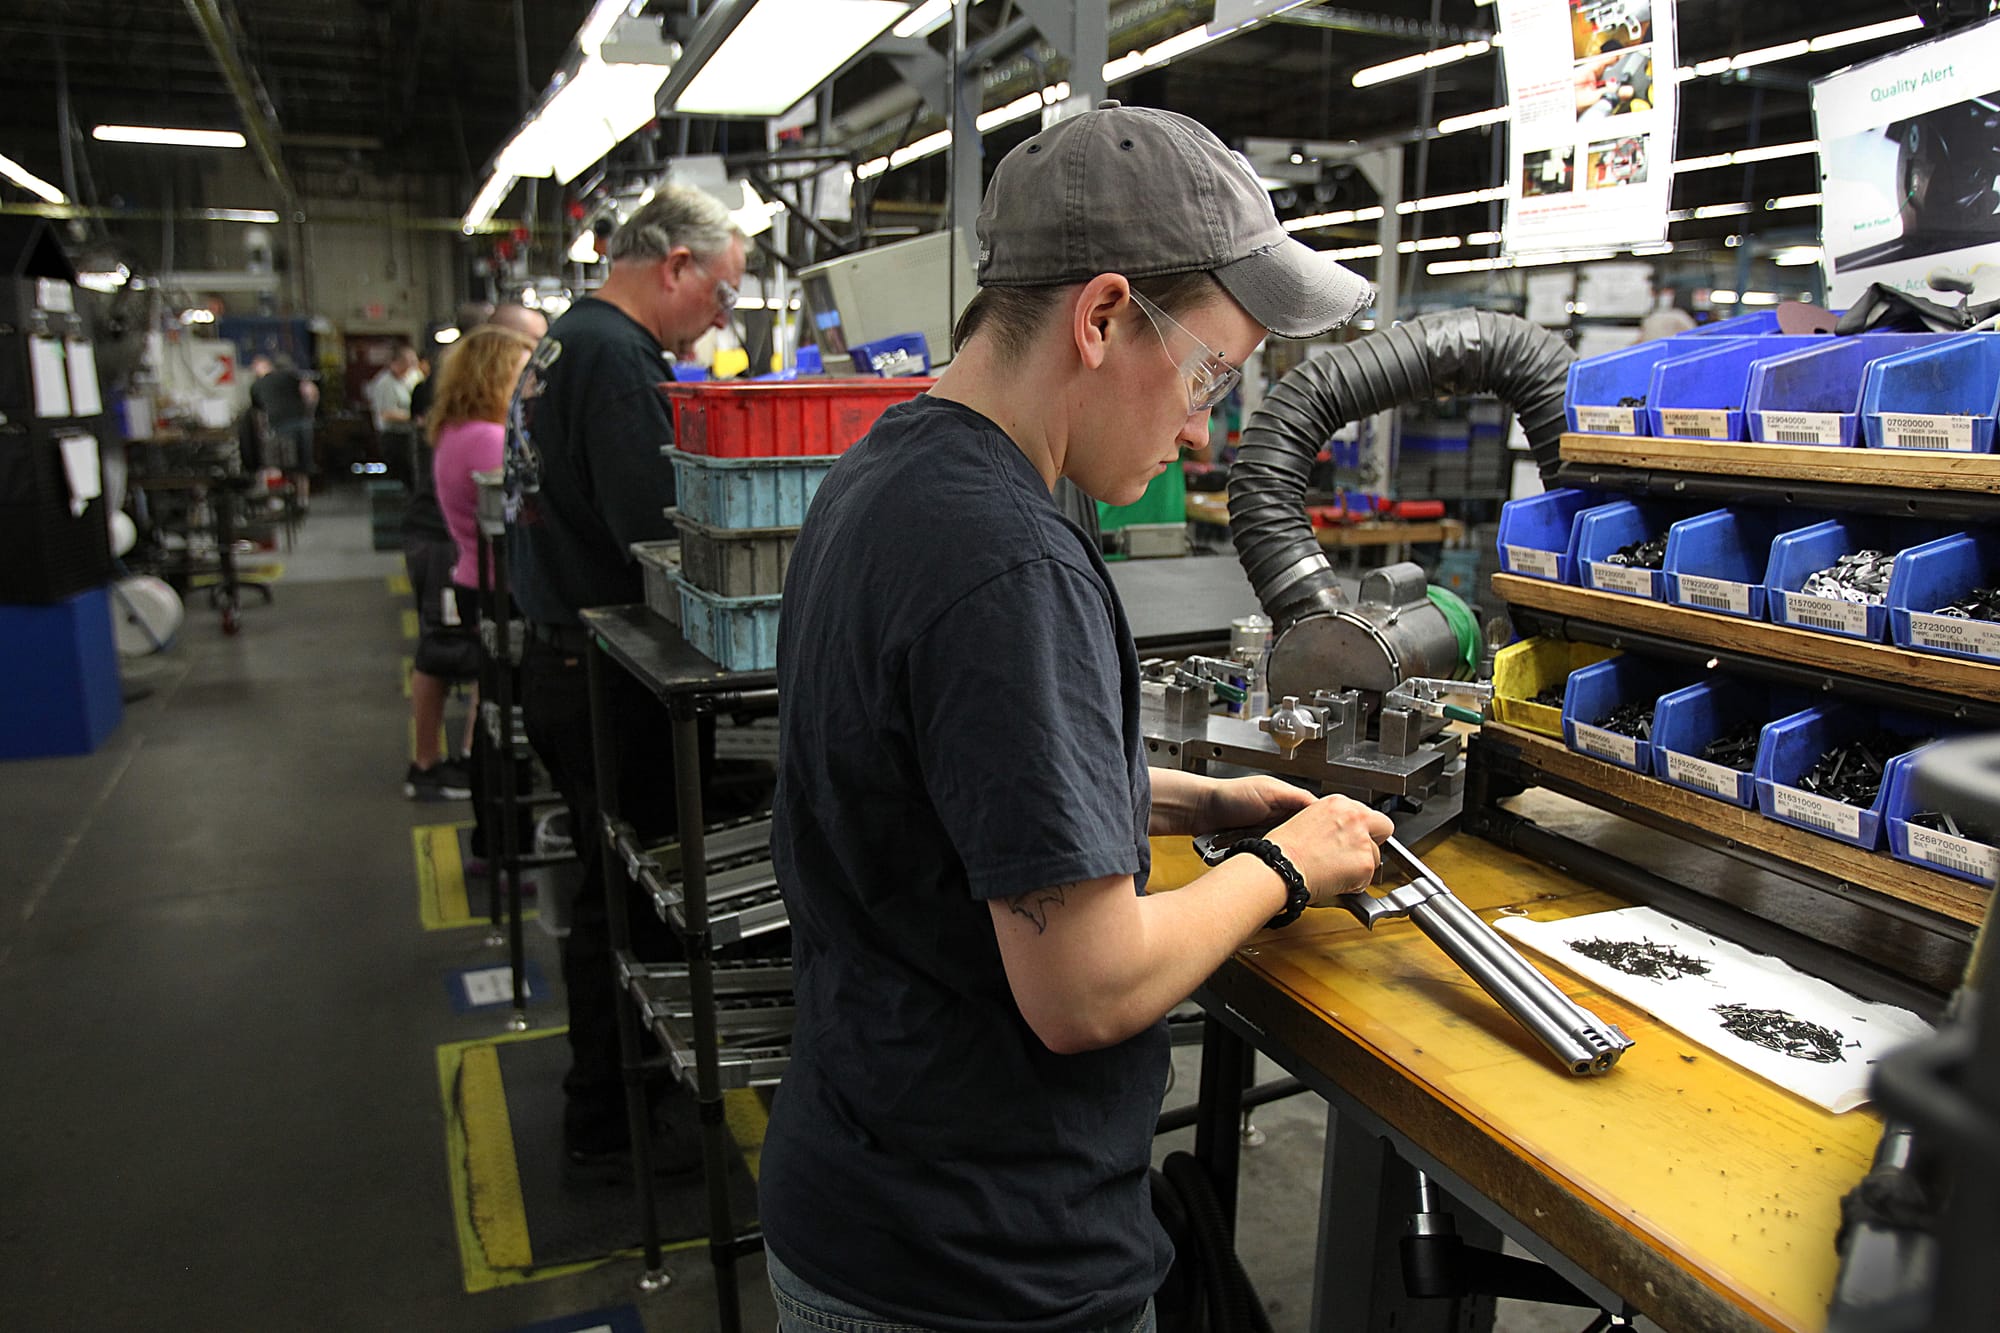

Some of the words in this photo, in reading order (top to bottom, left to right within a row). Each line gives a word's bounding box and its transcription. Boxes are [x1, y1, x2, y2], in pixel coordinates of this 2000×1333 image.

[1871, 78, 1917, 102] Quality
[1921, 65, 1954, 86] Alert
[1887, 418, 1934, 428] 070200000
[1788, 598, 1832, 611] 215700000
[1911, 621, 1963, 635] 227230000
[1913, 832, 1967, 854] 226870000
[1913, 840, 1928, 849] BOLT
